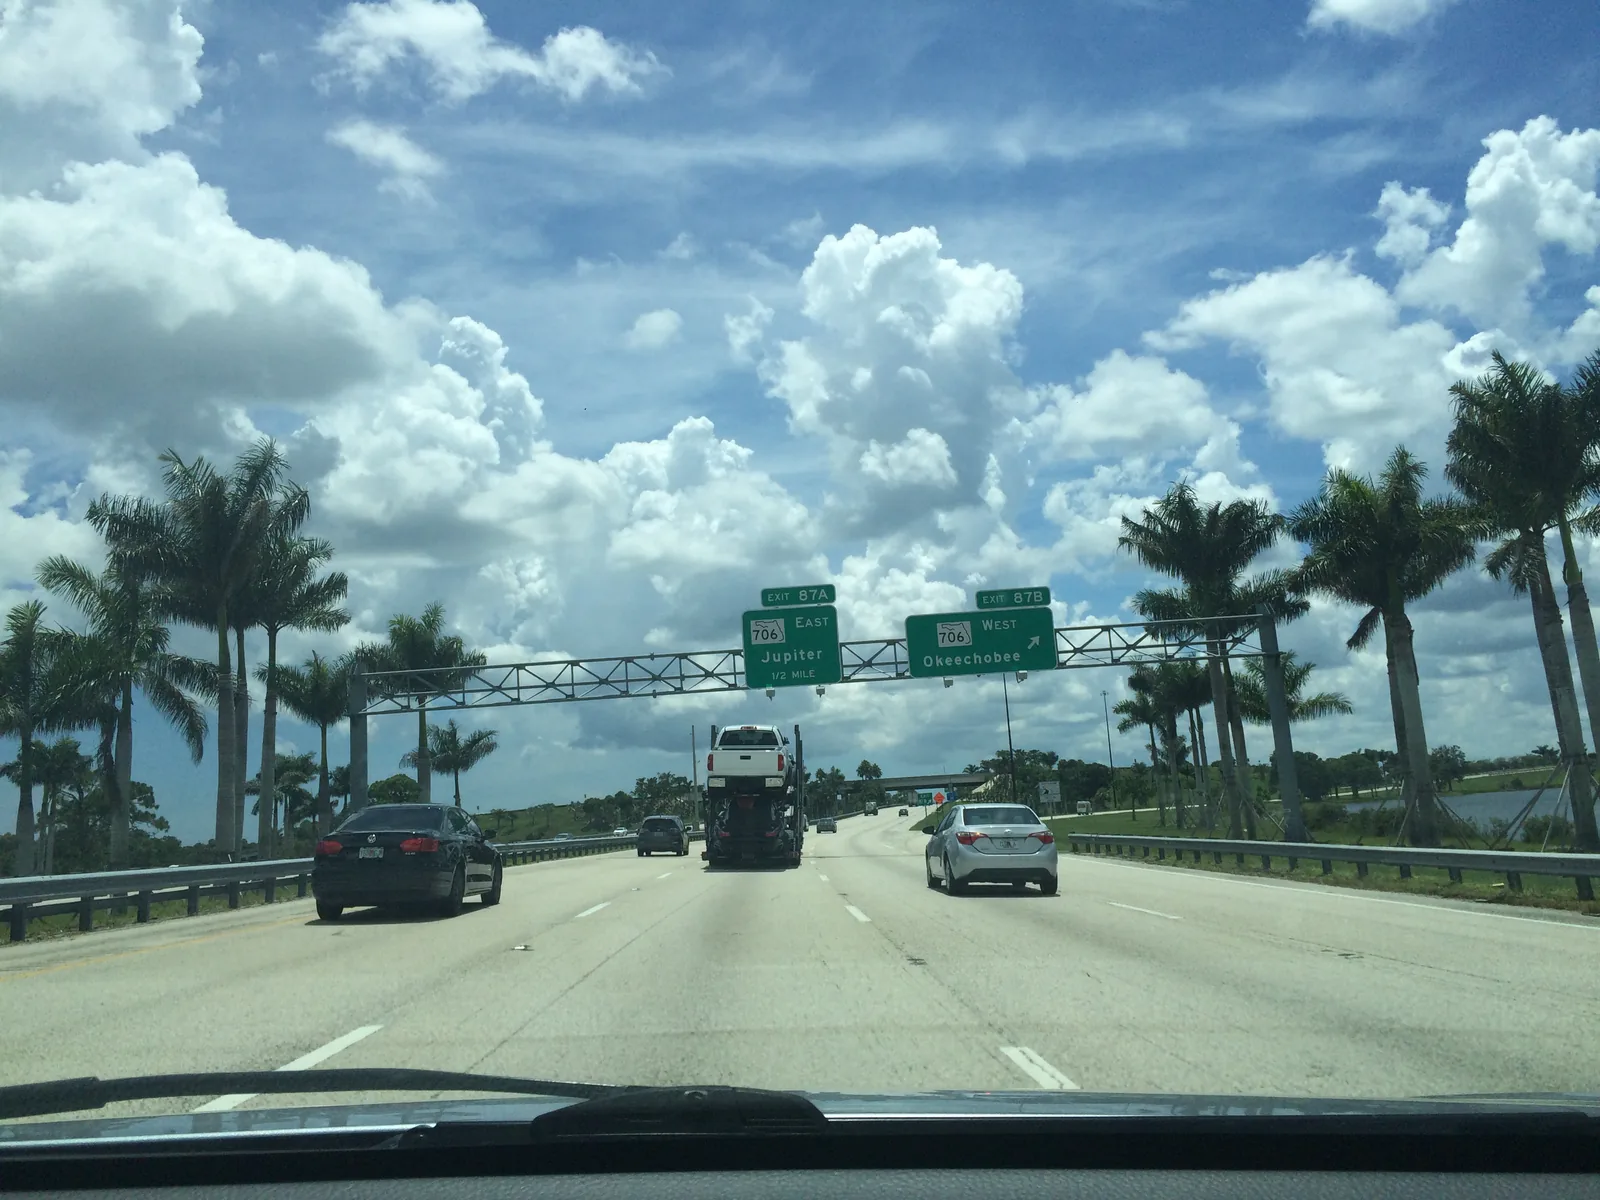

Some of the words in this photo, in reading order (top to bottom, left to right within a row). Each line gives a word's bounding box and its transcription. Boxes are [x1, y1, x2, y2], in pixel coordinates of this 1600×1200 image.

[767, 593, 790, 601] EXIT
[799, 589, 828, 601] 87A
[982, 595, 1004, 604] EXIT
[1013, 591, 1043, 604] 87B
[795, 617, 828, 628] EAST
[982, 619, 1017, 631] WEST
[752, 629, 778, 640] 706
[938, 632, 964, 643] 706
[761, 649, 822, 664] Jupiter
[923, 652, 1021, 667] Okeechobee
[771, 672, 786, 680] 1/2
[792, 670, 815, 679] MILE
